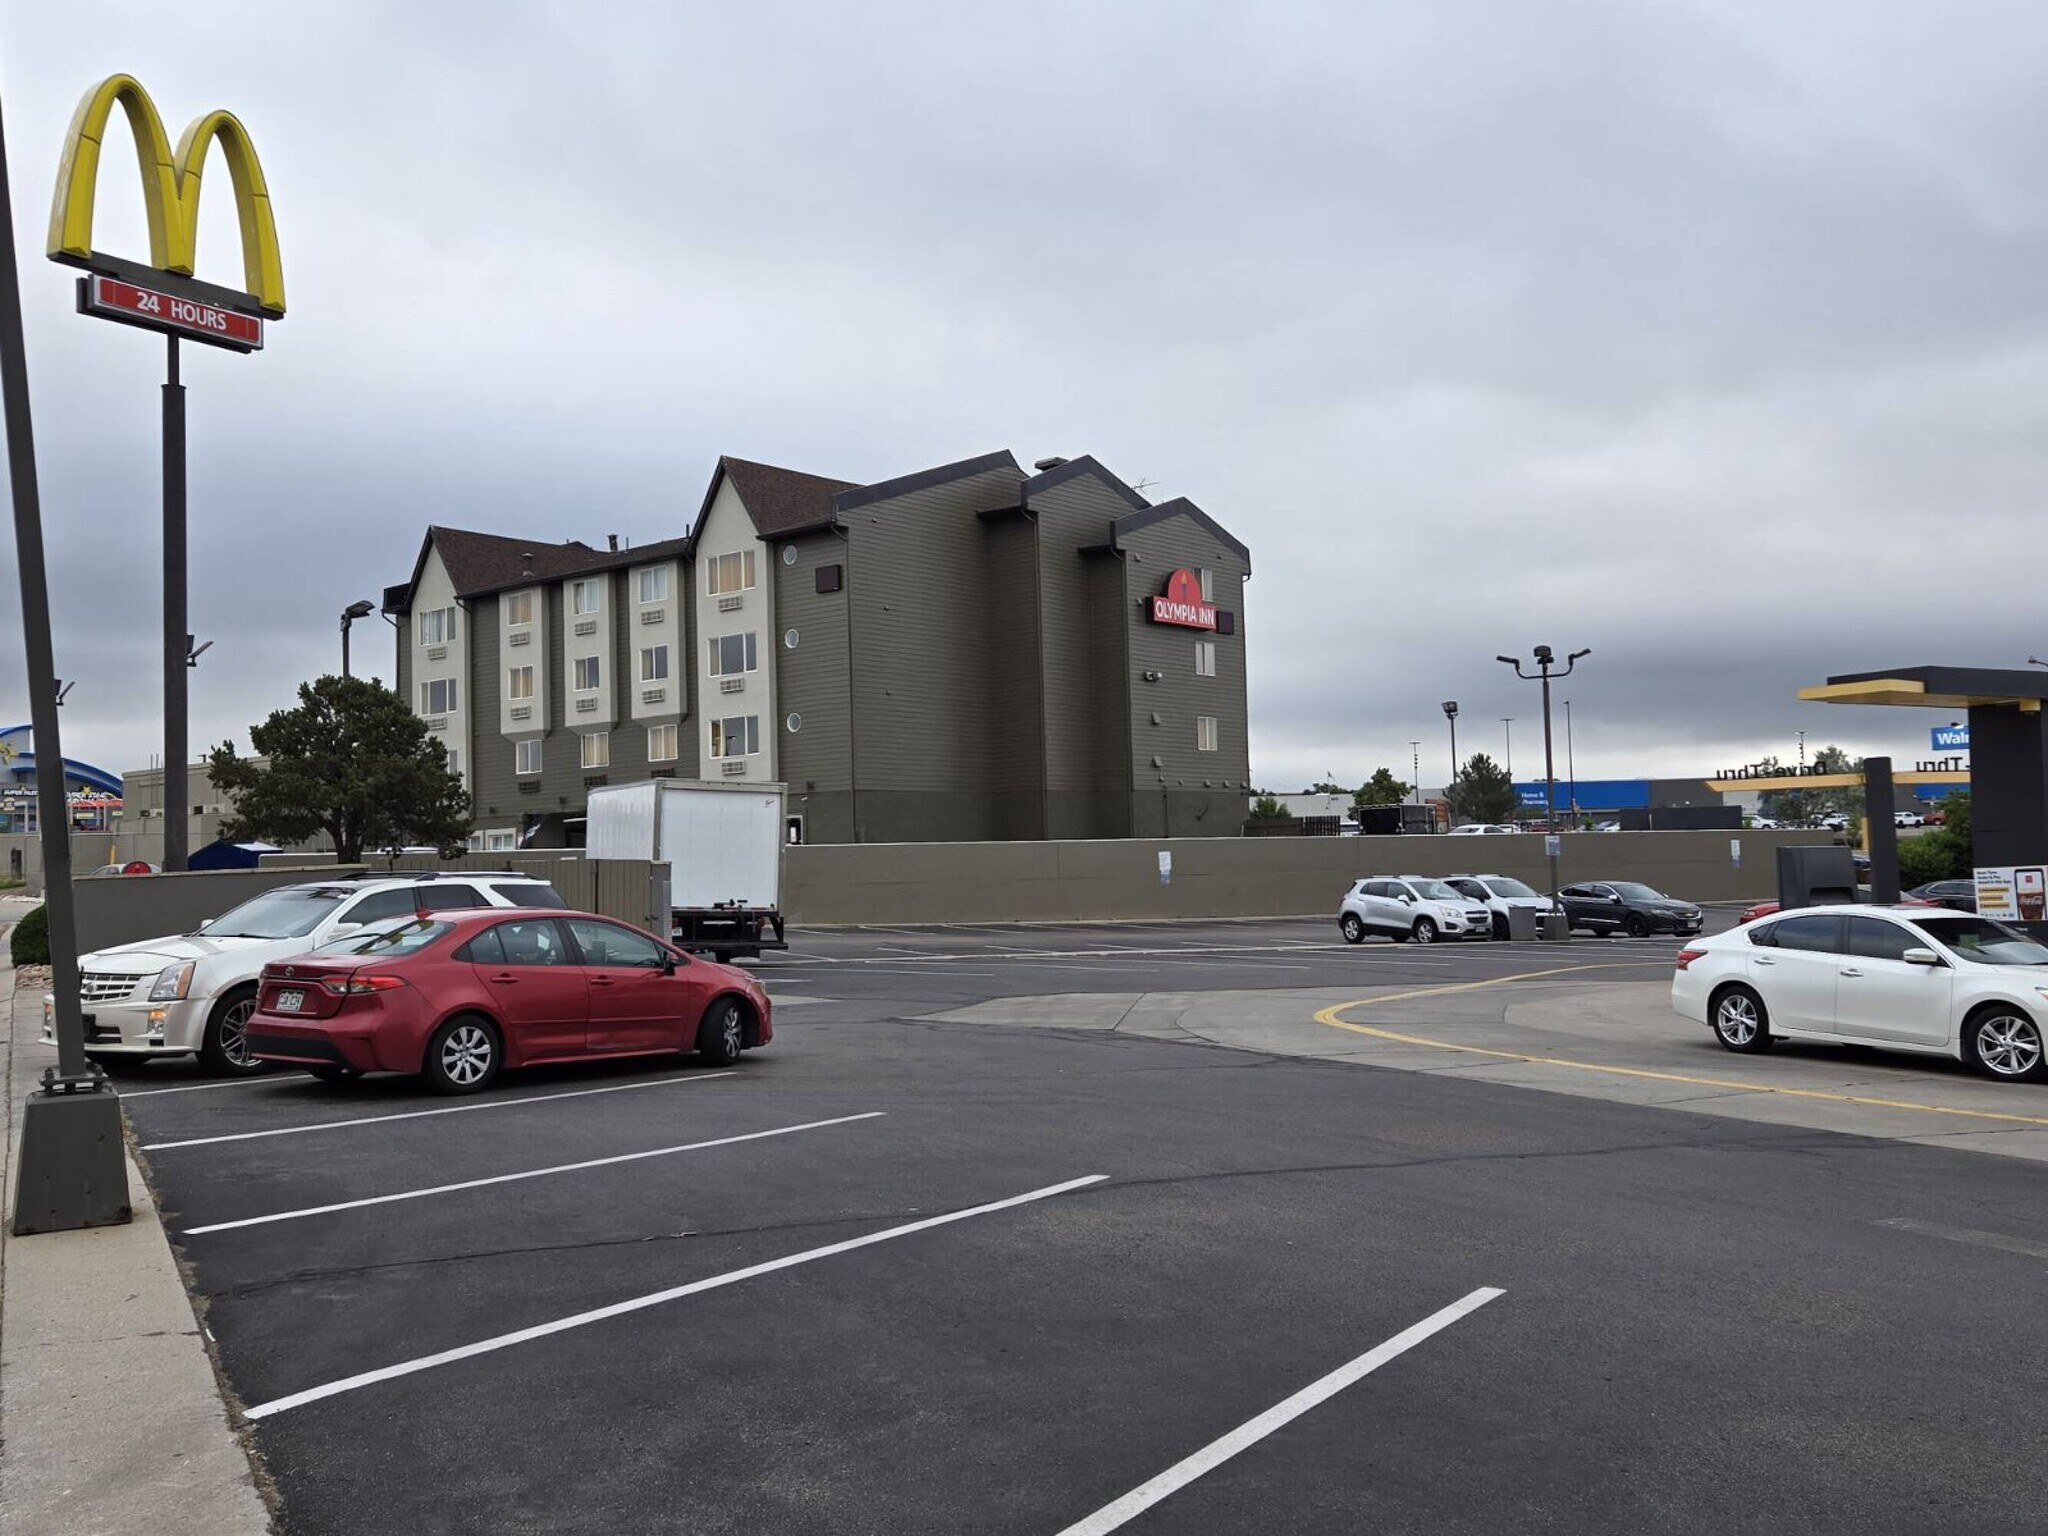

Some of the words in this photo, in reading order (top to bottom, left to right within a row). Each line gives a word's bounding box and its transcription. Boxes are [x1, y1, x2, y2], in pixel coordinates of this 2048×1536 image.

[137, 291, 160, 314] 24
[171, 300, 227, 331] HOURS
[1156, 600, 1197, 623] OLYMPIA
[1199, 606, 1215, 625] INN
